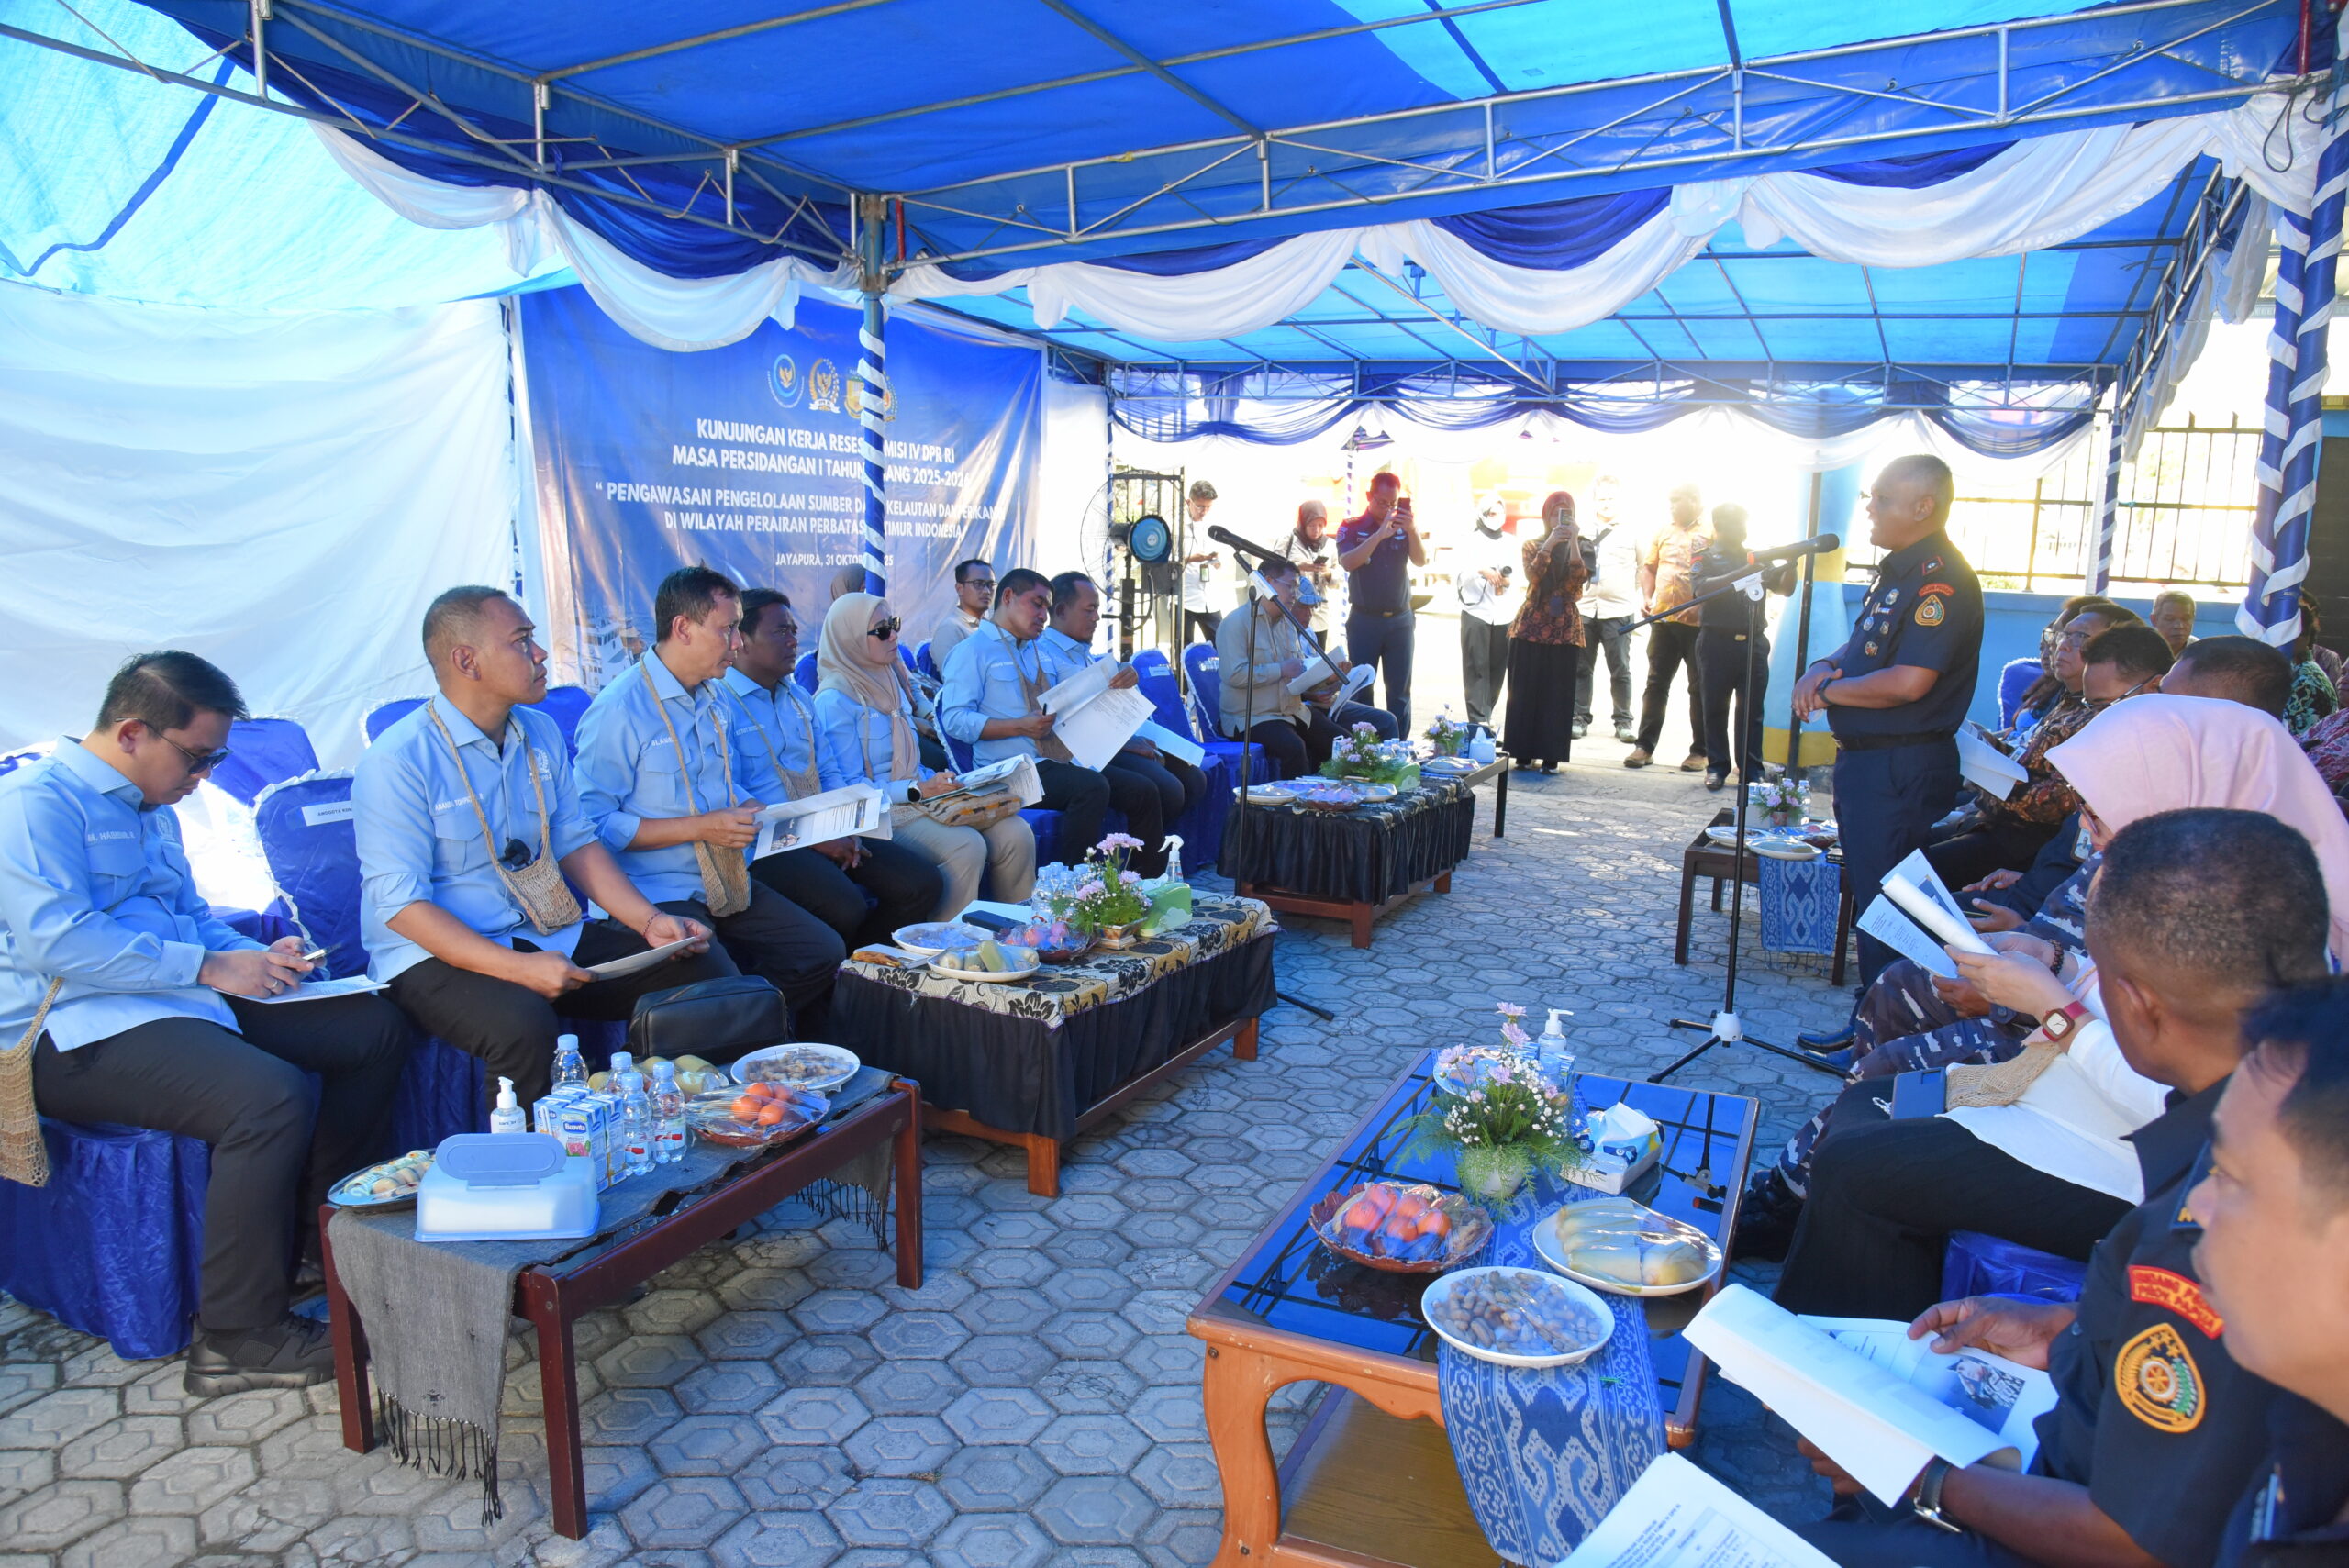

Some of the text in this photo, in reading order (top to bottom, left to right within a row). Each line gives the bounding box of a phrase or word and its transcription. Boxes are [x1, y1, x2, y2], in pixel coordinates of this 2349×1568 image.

[697, 418, 785, 447] KUNJUNGAN
[788, 428, 827, 450] KERJA
[884, 439, 907, 459] MISI
[909, 443, 920, 460] IV
[922, 445, 942, 462] DPR
[944, 448, 955, 464] RI
[673, 445, 718, 468] MASA
[721, 450, 816, 475] PERSIDANGAN
[818, 460, 823, 476] I
[825, 459, 865, 479] TAHUN
[885, 464, 911, 484] ANG
[607, 482, 711, 506] PENGAWASAN
[716, 489, 805, 510] PENGELOLAAN
[808, 495, 852, 513] SUMBER
[887, 500, 936, 517] KELAUTAN
[664, 511, 962, 539] DI WILAYAH PERAIRAN PERBATAS TIMUR INDONESIA
[775, 553, 894, 568] JAYAPURA, 31 OKTOB 25
[564, 1122, 585, 1130] Buavita
